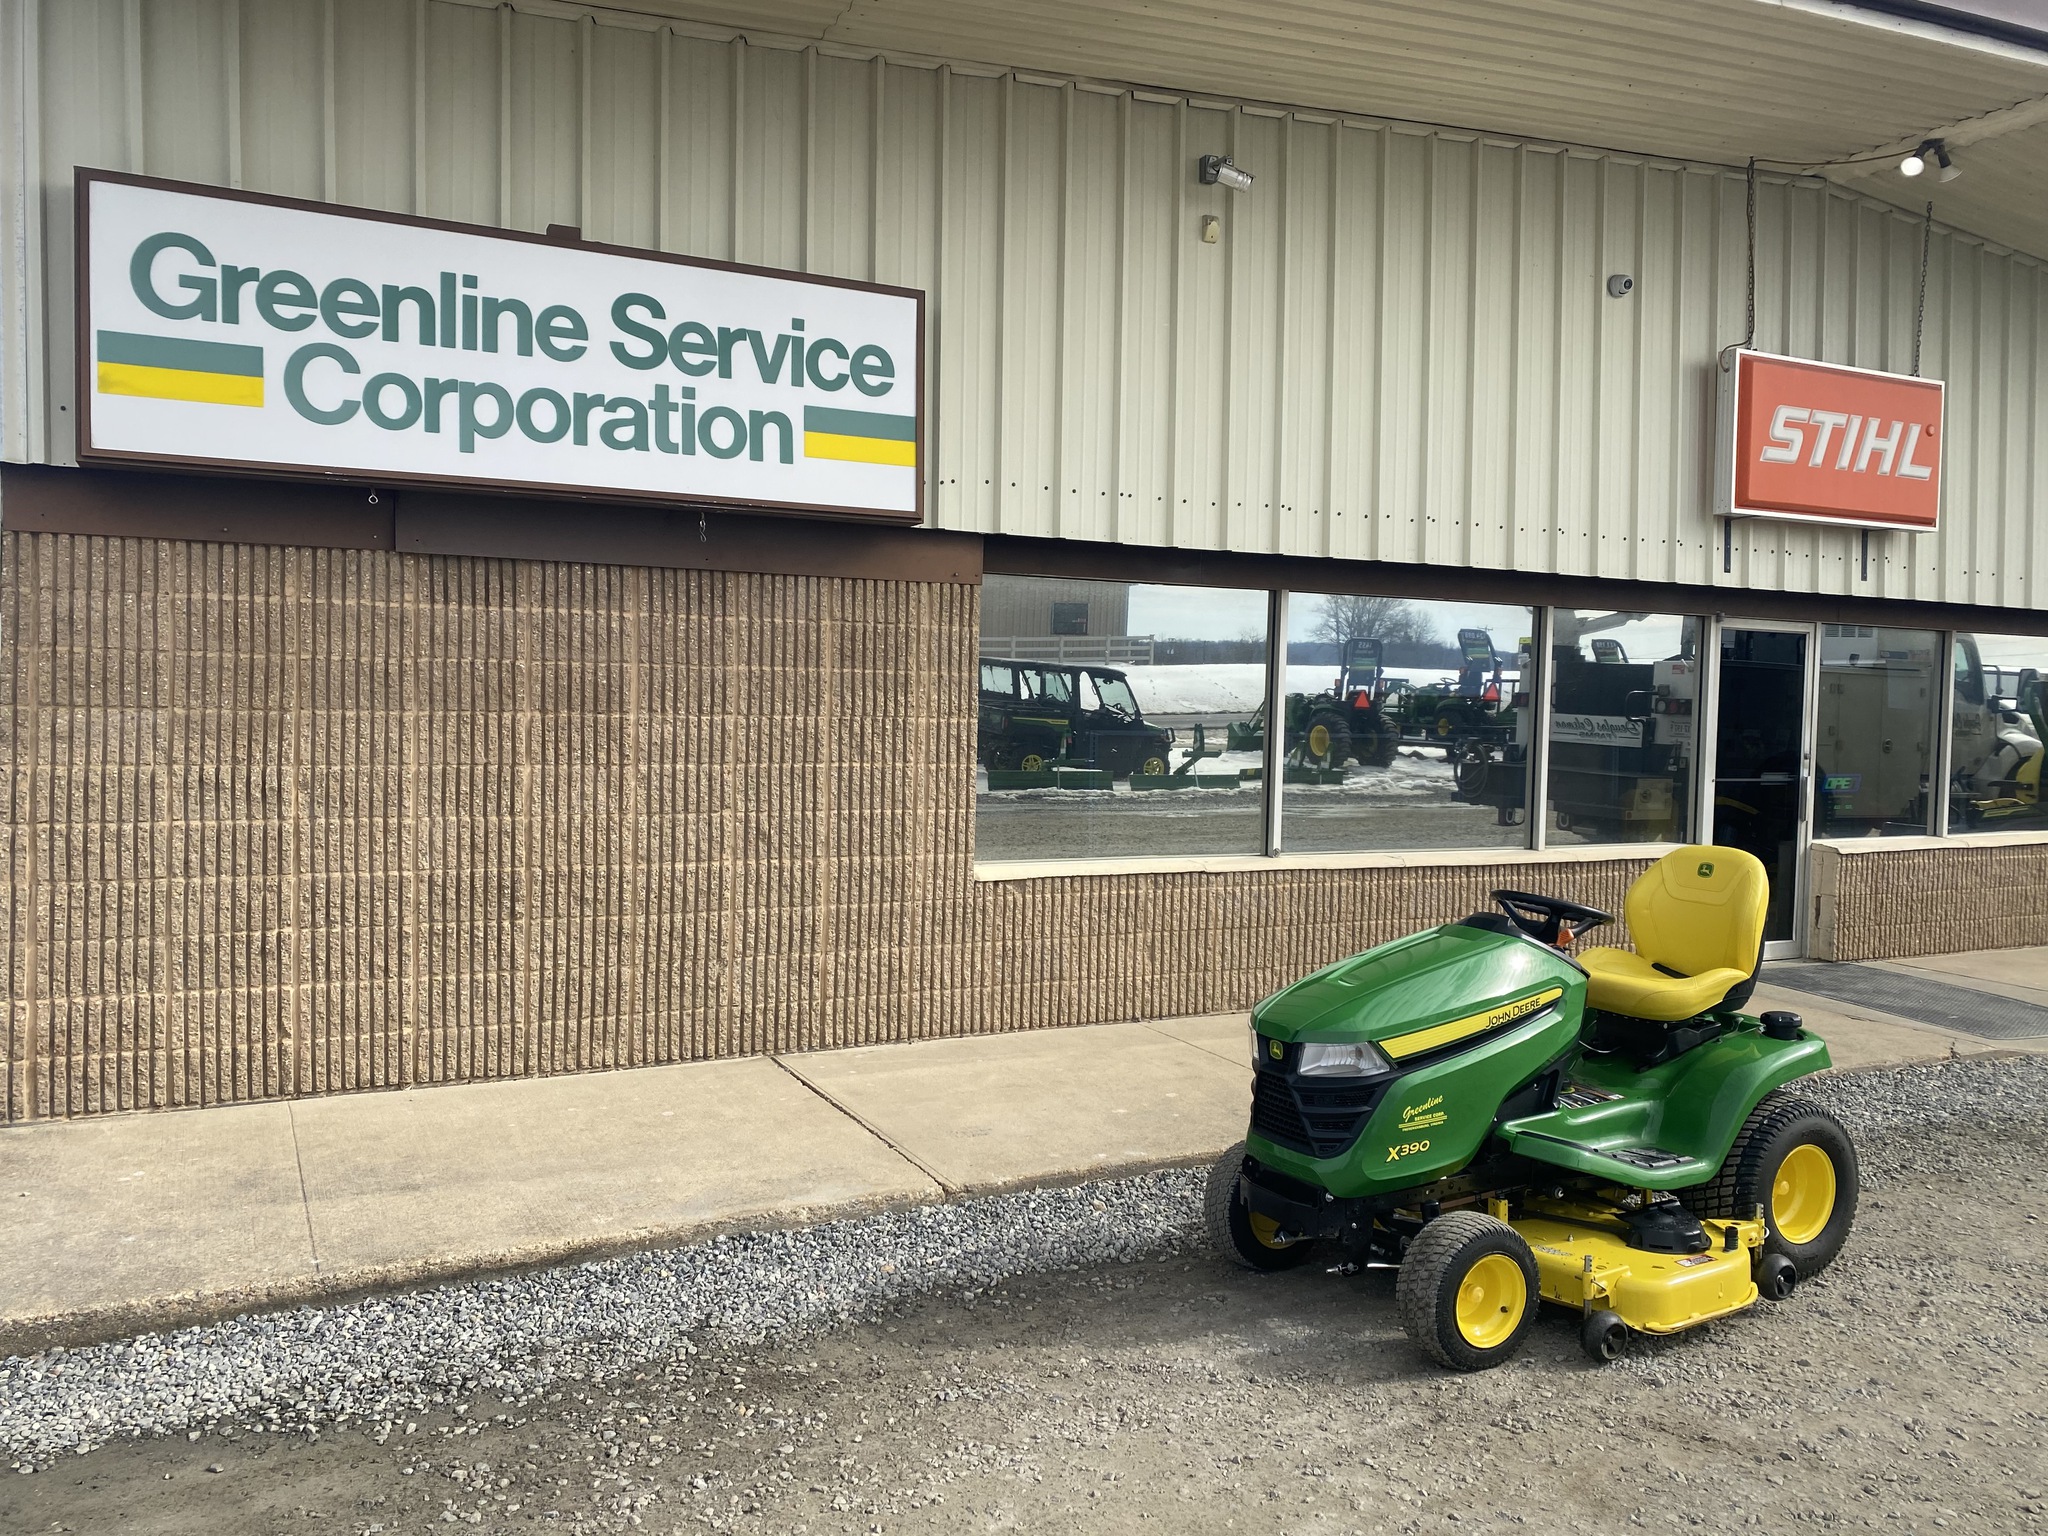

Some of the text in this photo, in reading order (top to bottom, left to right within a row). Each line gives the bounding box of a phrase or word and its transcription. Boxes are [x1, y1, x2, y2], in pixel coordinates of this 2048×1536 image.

[129, 231, 895, 398] Greenline Service
[284, 342, 795, 464] Corporation
[1759, 404, 1933, 482] STIHL
[1485, 997, 1541, 1028] JOHN DEERE
[1402, 1095, 1444, 1122] Greenline
[1386, 1139, 1430, 1162] X390
